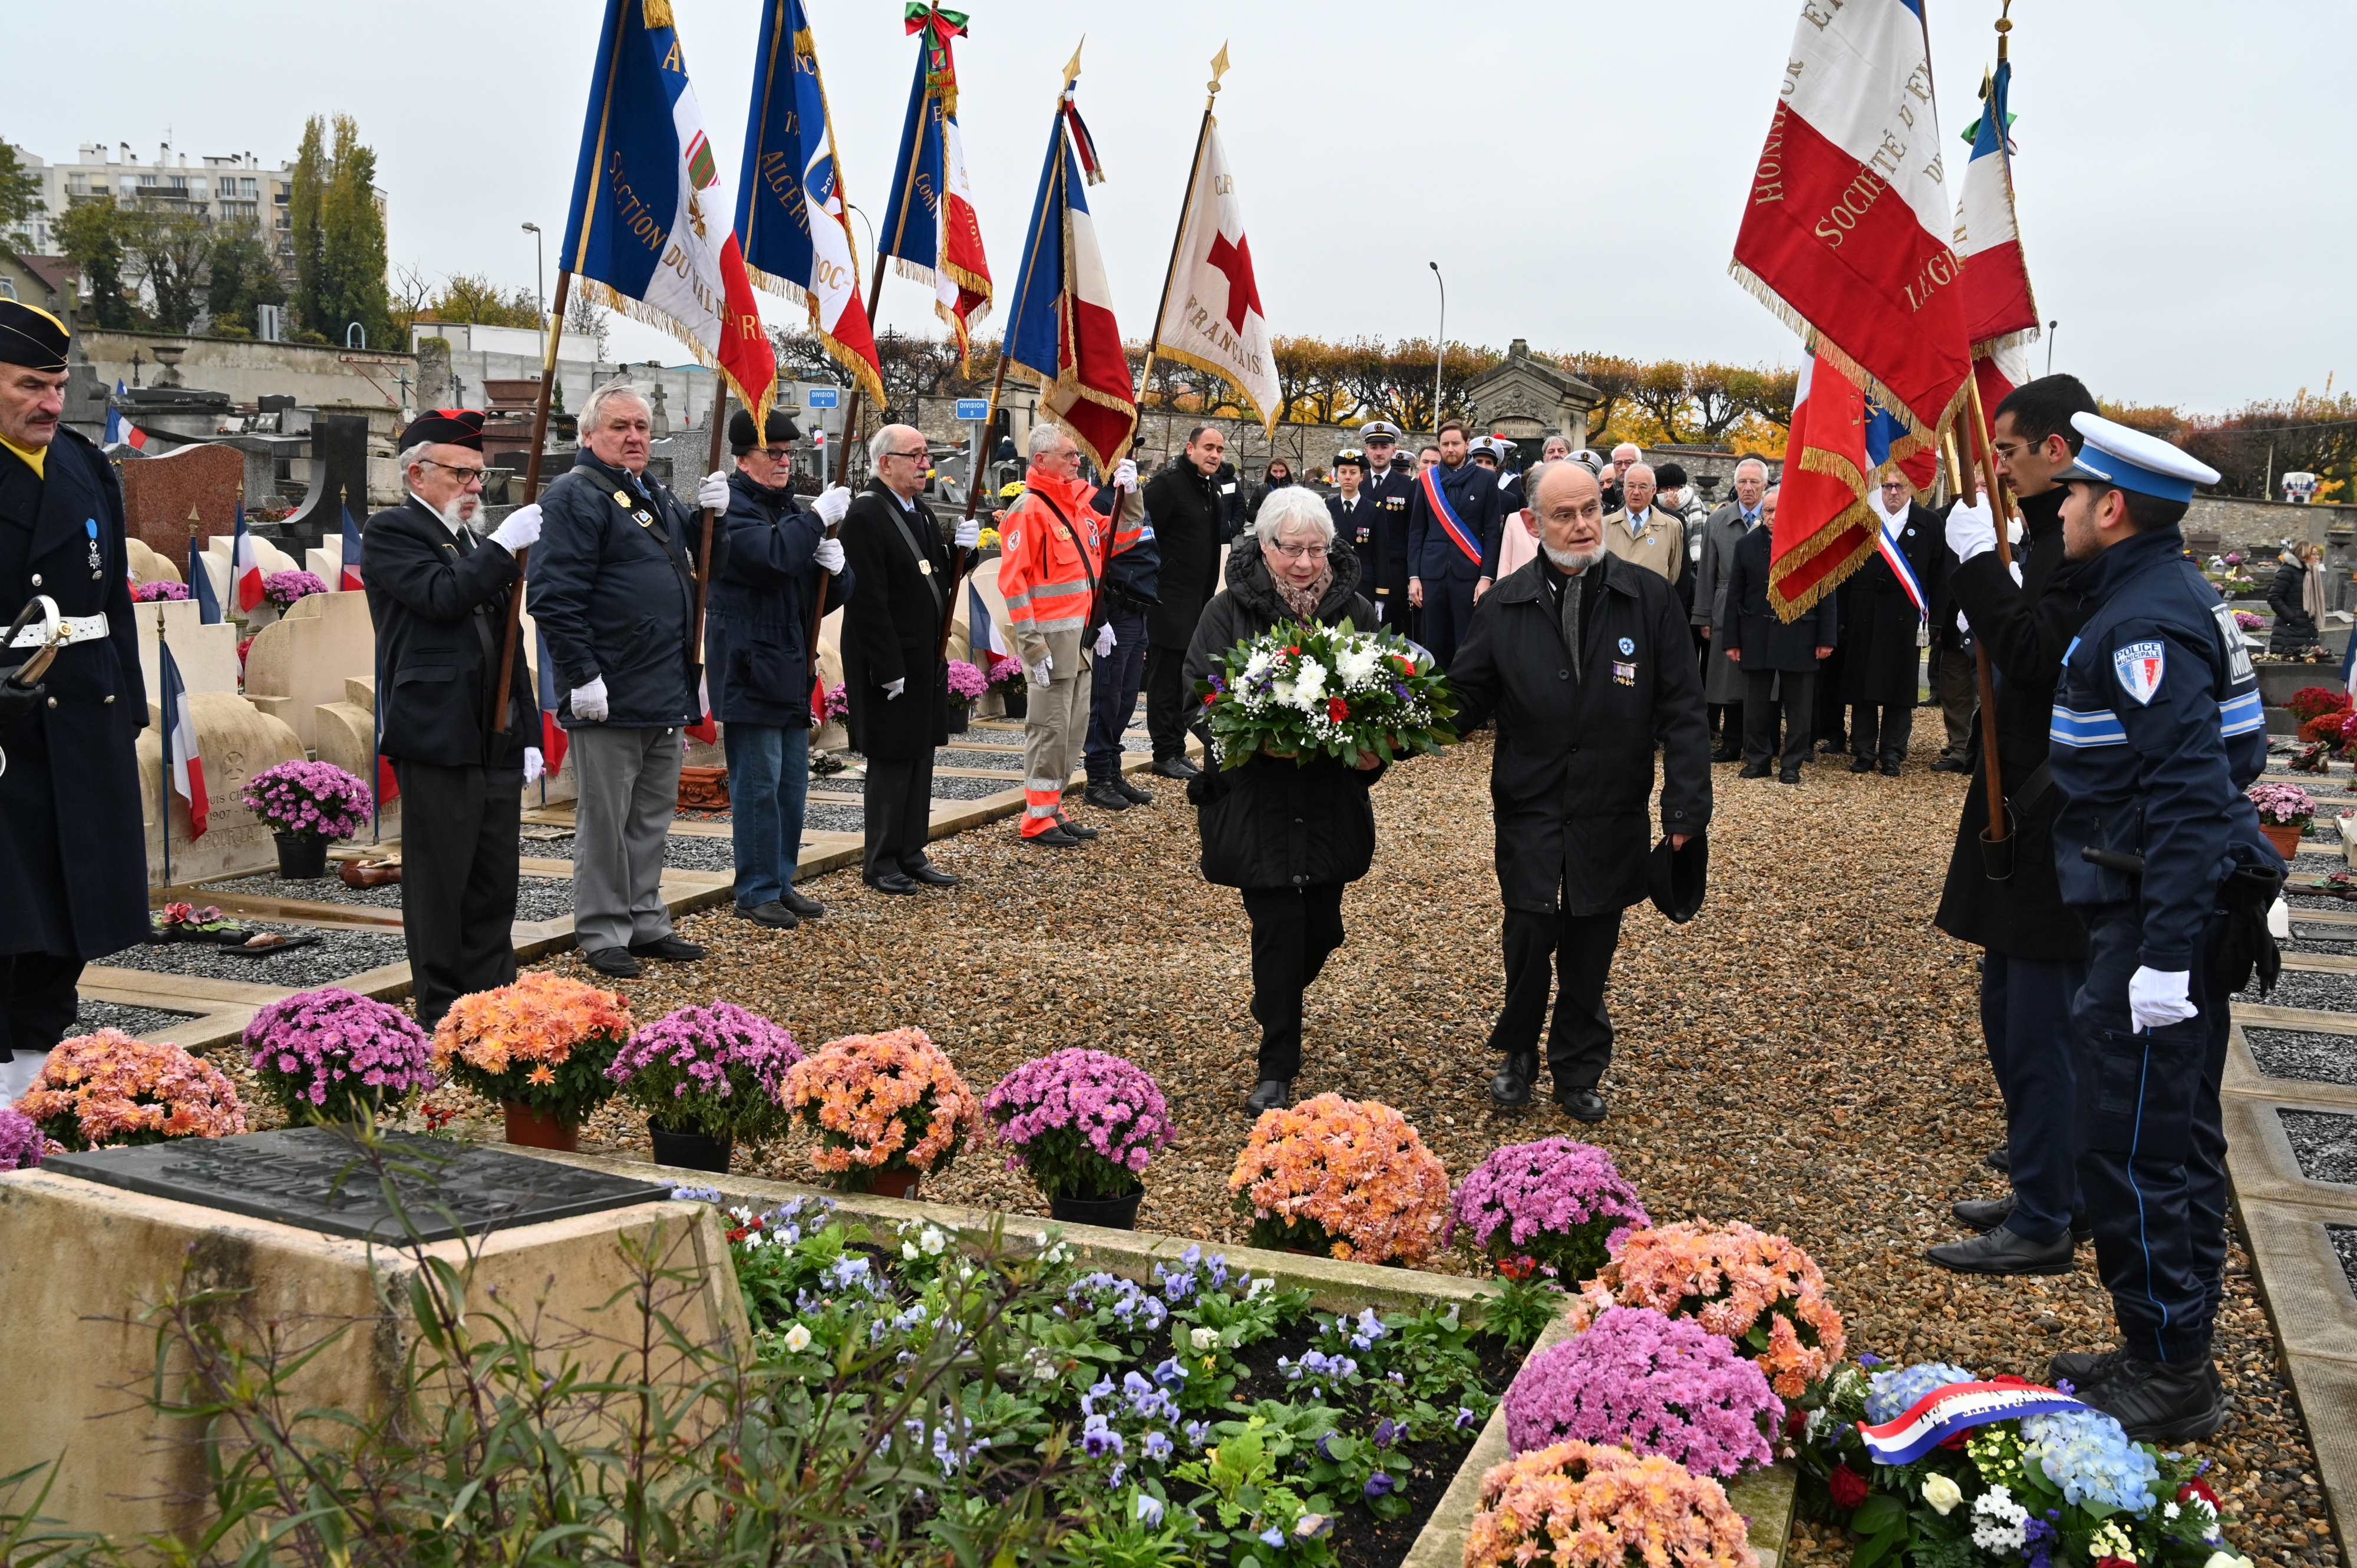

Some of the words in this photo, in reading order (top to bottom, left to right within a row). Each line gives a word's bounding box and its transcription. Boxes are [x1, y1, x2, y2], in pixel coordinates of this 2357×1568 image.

[609, 151, 668, 251] SECTION
[662, 244, 692, 279] DU
[693, 268, 714, 314] VAL
[2115, 643, 2160, 660] POLICE
[2117, 651, 2161, 666] MUNICIPALE
[209, 810, 231, 821] 1907
